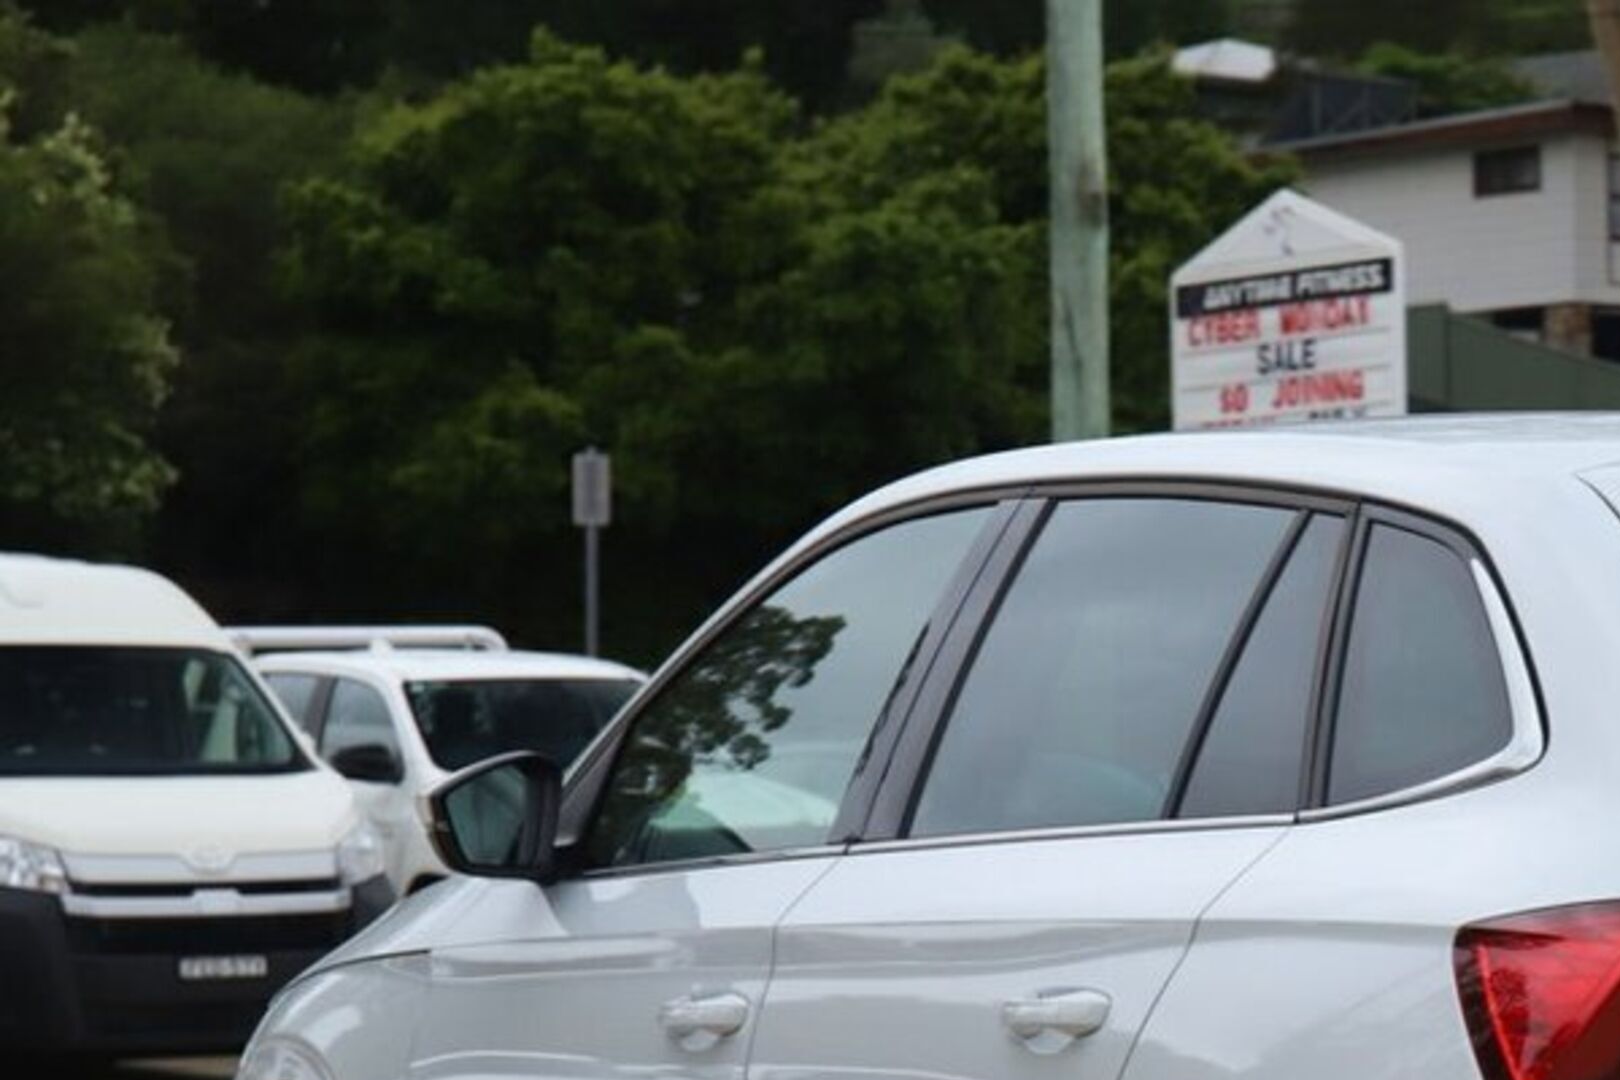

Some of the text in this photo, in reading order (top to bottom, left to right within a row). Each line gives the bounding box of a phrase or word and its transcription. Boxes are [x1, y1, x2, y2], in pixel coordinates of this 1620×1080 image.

[1187, 308, 1260, 346] CYBER
[1256, 339, 1316, 375] SALE
[1272, 369, 1364, 408] JOINING
